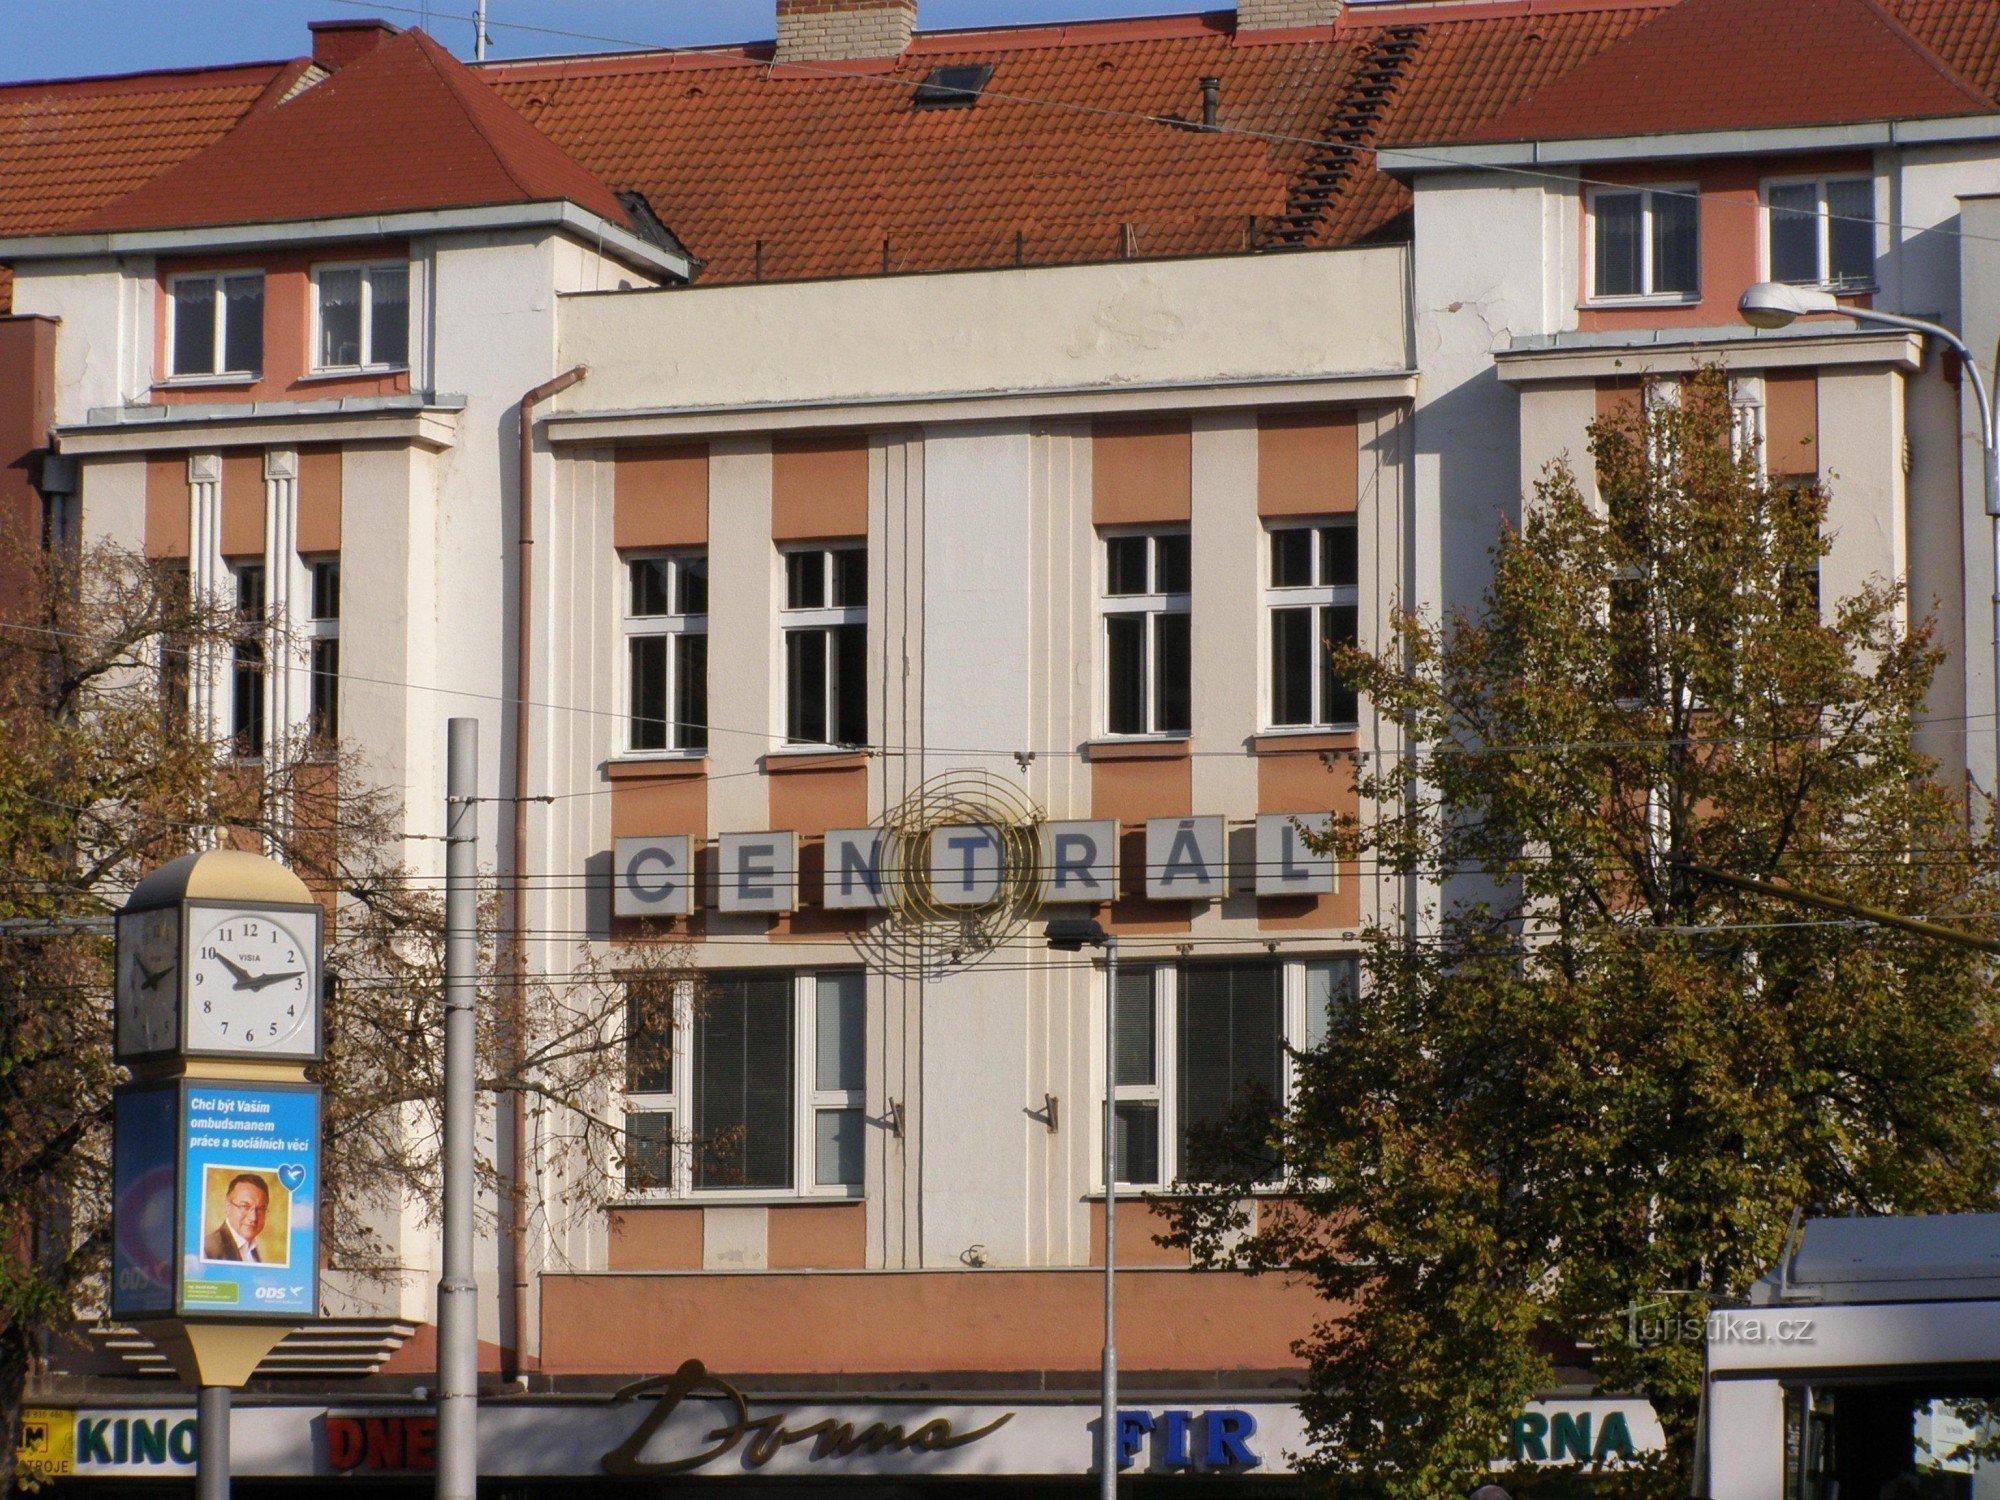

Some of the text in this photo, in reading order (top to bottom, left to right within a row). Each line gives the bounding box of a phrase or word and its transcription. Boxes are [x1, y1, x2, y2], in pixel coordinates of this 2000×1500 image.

[626, 817, 1309, 901] CENTRÁL
[219, 929, 232, 941] 11
[243, 923, 258, 937] 12
[271, 931, 277, 943] 1
[201, 946, 216, 959] 10
[287, 950, 295, 963] 2
[195, 973, 204, 986] 9
[294, 978, 302, 991] 3
[203, 1000, 212, 1013] 8
[287, 1004, 295, 1017] 4
[220, 1022, 228, 1035] 7
[245, 1029, 253, 1041] 6
[269, 1022, 277, 1035] 5
[191, 1098, 270, 1114] Chci být Vaším
[190, 1117, 275, 1131] ombudsmanem
[190, 1134, 309, 1151] práce a sociálních věcí
[255, 1287, 286, 1299] ODS
[601, 1359, 1015, 1475] Donna
